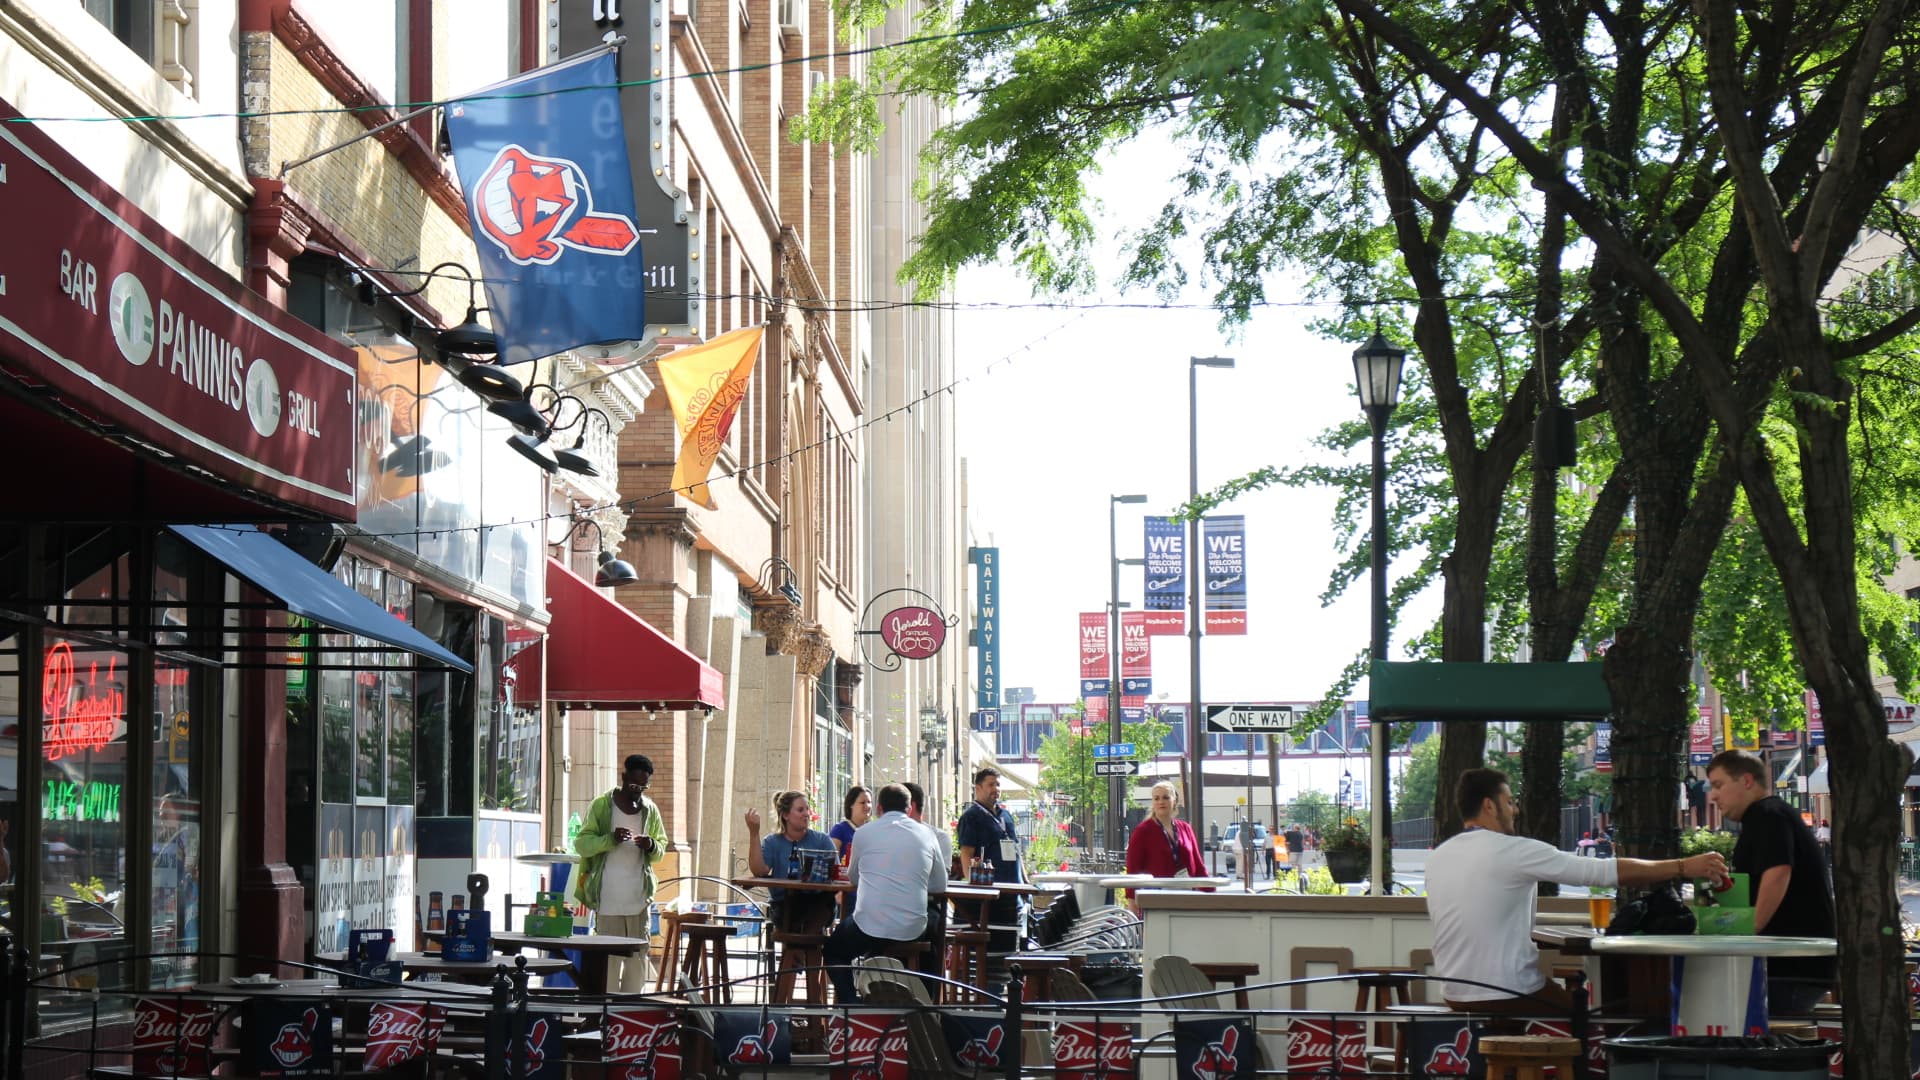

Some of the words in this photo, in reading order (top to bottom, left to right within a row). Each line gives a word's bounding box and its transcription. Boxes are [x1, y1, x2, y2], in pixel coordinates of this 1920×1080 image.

[60, 249, 97, 315] BAR
[158, 298, 243, 411] PANINIS
[288, 390, 320, 438] GRILL
[1148, 536, 1182, 552] WE
[1208, 535, 1242, 552] WE
[983, 553, 994, 645] GATEWAY
[1082, 626, 1106, 638] WE
[984, 651, 993, 703] EAST
[1229, 712, 1254, 726] ONE
[1260, 711, 1287, 726] WAY
[1888, 706, 1915, 719] TAP
[985, 714, 994, 727] P
[1099, 747, 1107, 755] E.
[1110, 746, 1117, 754] 8
[1119, 745, 1129, 753] St
